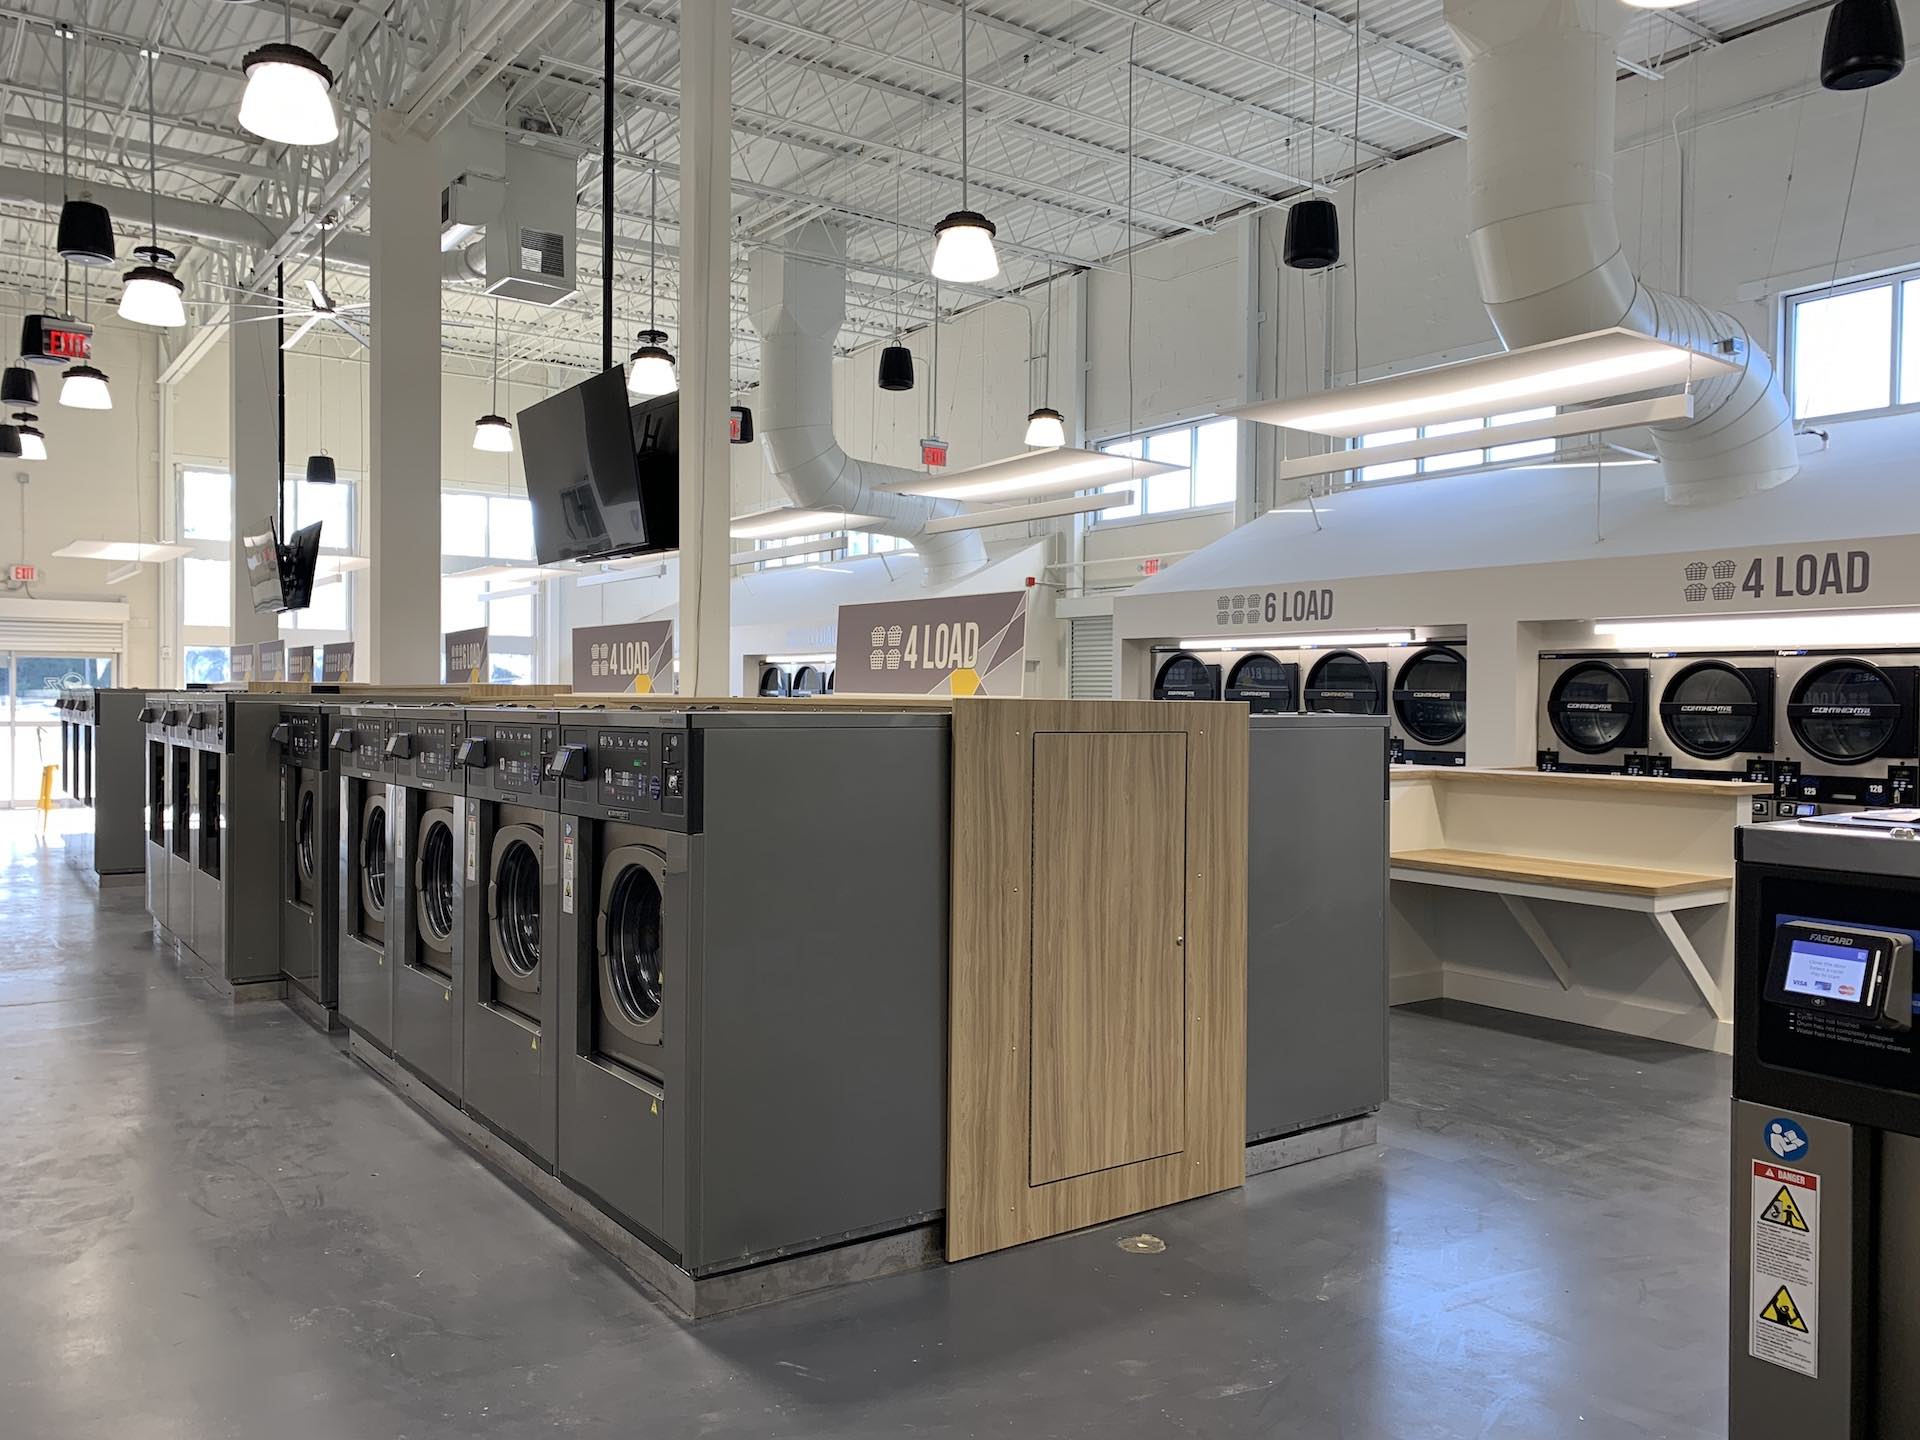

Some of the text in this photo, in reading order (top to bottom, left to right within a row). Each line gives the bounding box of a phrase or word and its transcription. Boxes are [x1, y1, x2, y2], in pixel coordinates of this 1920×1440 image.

[50, 330, 87, 358] EXIT
[15, 566, 35, 580] EXIT
[1742, 550, 1870, 598] 4 LOAD
[1264, 589, 1334, 622] 6 LOAD
[903, 621, 979, 669] 4 LOAD
[610, 641, 649, 675] 4 LOAD
[1804, 787, 1816, 796] 125
[1809, 933, 1853, 946] FASCARD
[1793, 979, 1808, 987] VISA
[1777, 1169, 1806, 1186] DANGER
